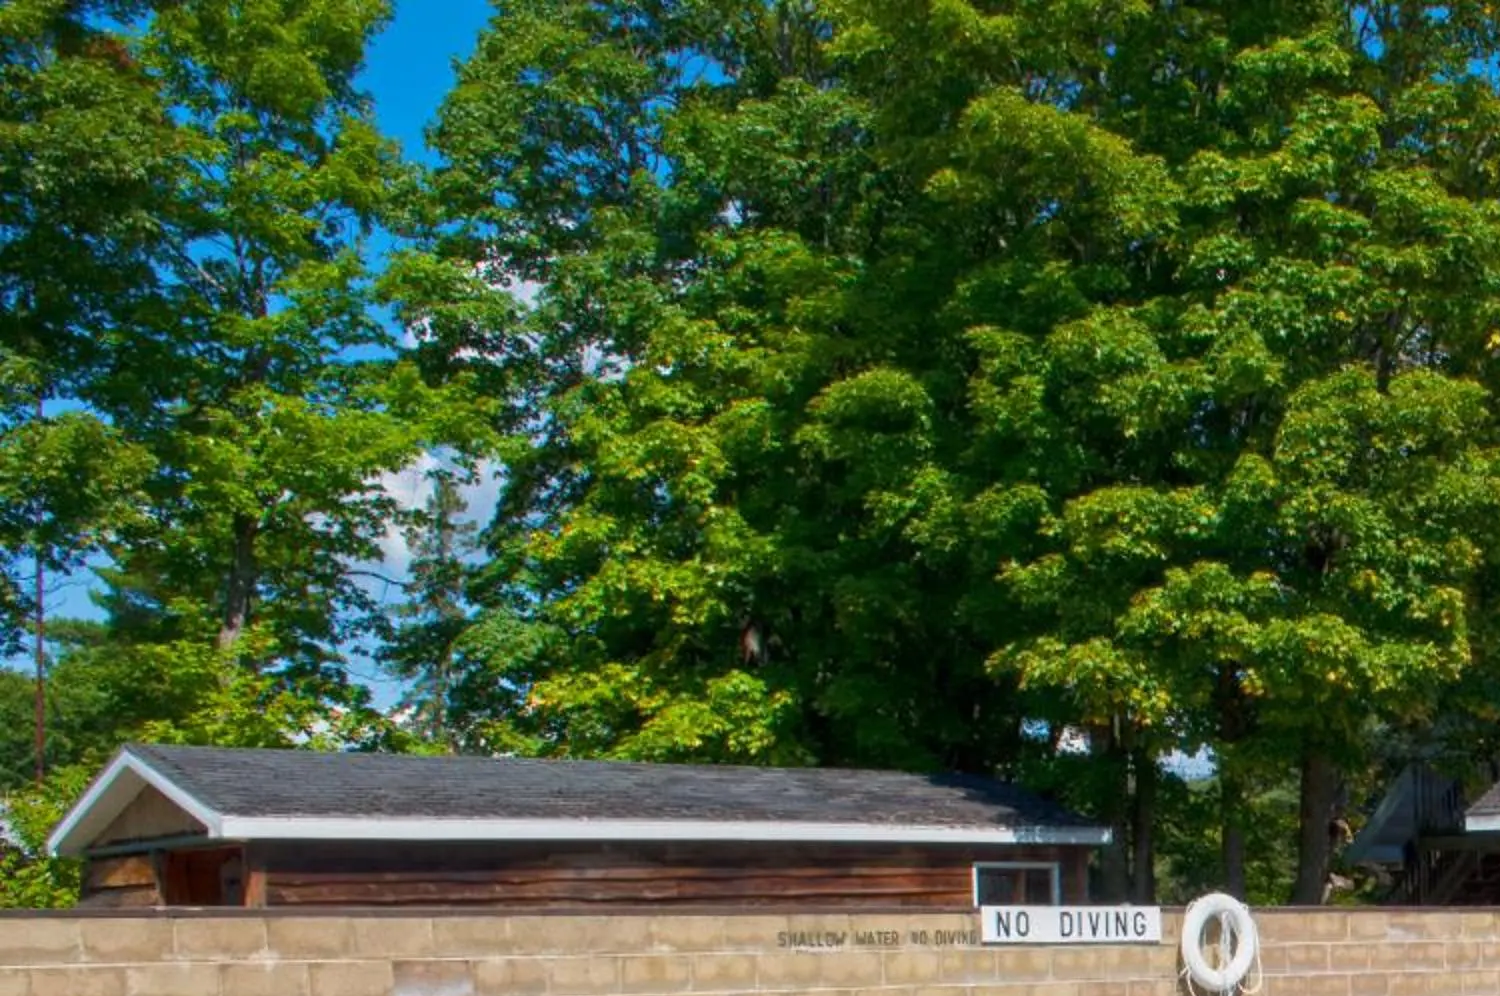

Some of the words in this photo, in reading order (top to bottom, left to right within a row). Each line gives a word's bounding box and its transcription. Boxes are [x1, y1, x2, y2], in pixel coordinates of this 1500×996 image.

[996, 911, 1030, 938] NO
[1060, 911, 1147, 938] DIVING
[777, 931, 848, 947] SHALLOW
[855, 931, 899, 946] WATER
